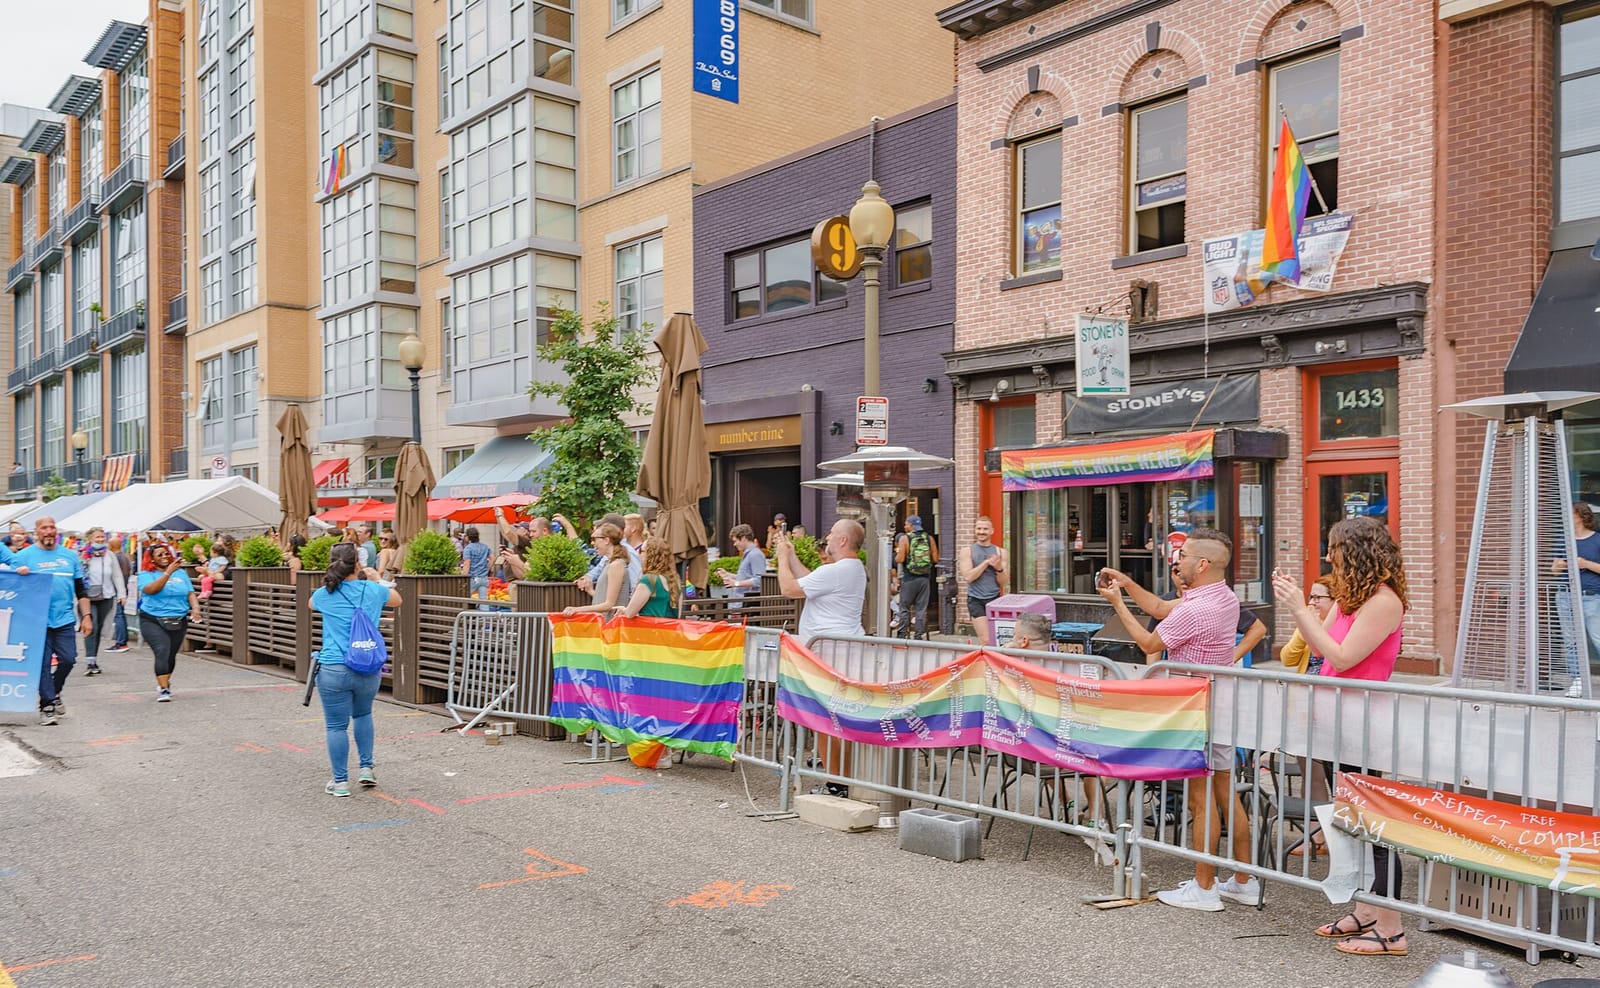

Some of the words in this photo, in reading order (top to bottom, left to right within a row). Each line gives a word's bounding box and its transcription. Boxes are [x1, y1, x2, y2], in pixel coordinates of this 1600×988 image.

[829, 223, 856, 271] 9
[1205, 247, 1236, 261] LIGHT
[1208, 239, 1233, 252] BUD
[1213, 287, 1231, 301] NFL
[1080, 321, 1125, 343] STONEY'S
[1081, 366, 1097, 377] FOOD
[1106, 387, 1206, 413] STONEY'S
[1336, 387, 1385, 410] 1433
[719, 427, 759, 445] number
[760, 425, 784, 441] nine
[1029, 461, 1071, 479] LOVE
[1073, 455, 1133, 475] ALWAYS
[1136, 447, 1183, 470] WINS
[0, 683, 27, 698] DC
[1430, 791, 1512, 830] RESPECT
[1520, 812, 1558, 827] FREE
[1333, 806, 1386, 842] GAY
